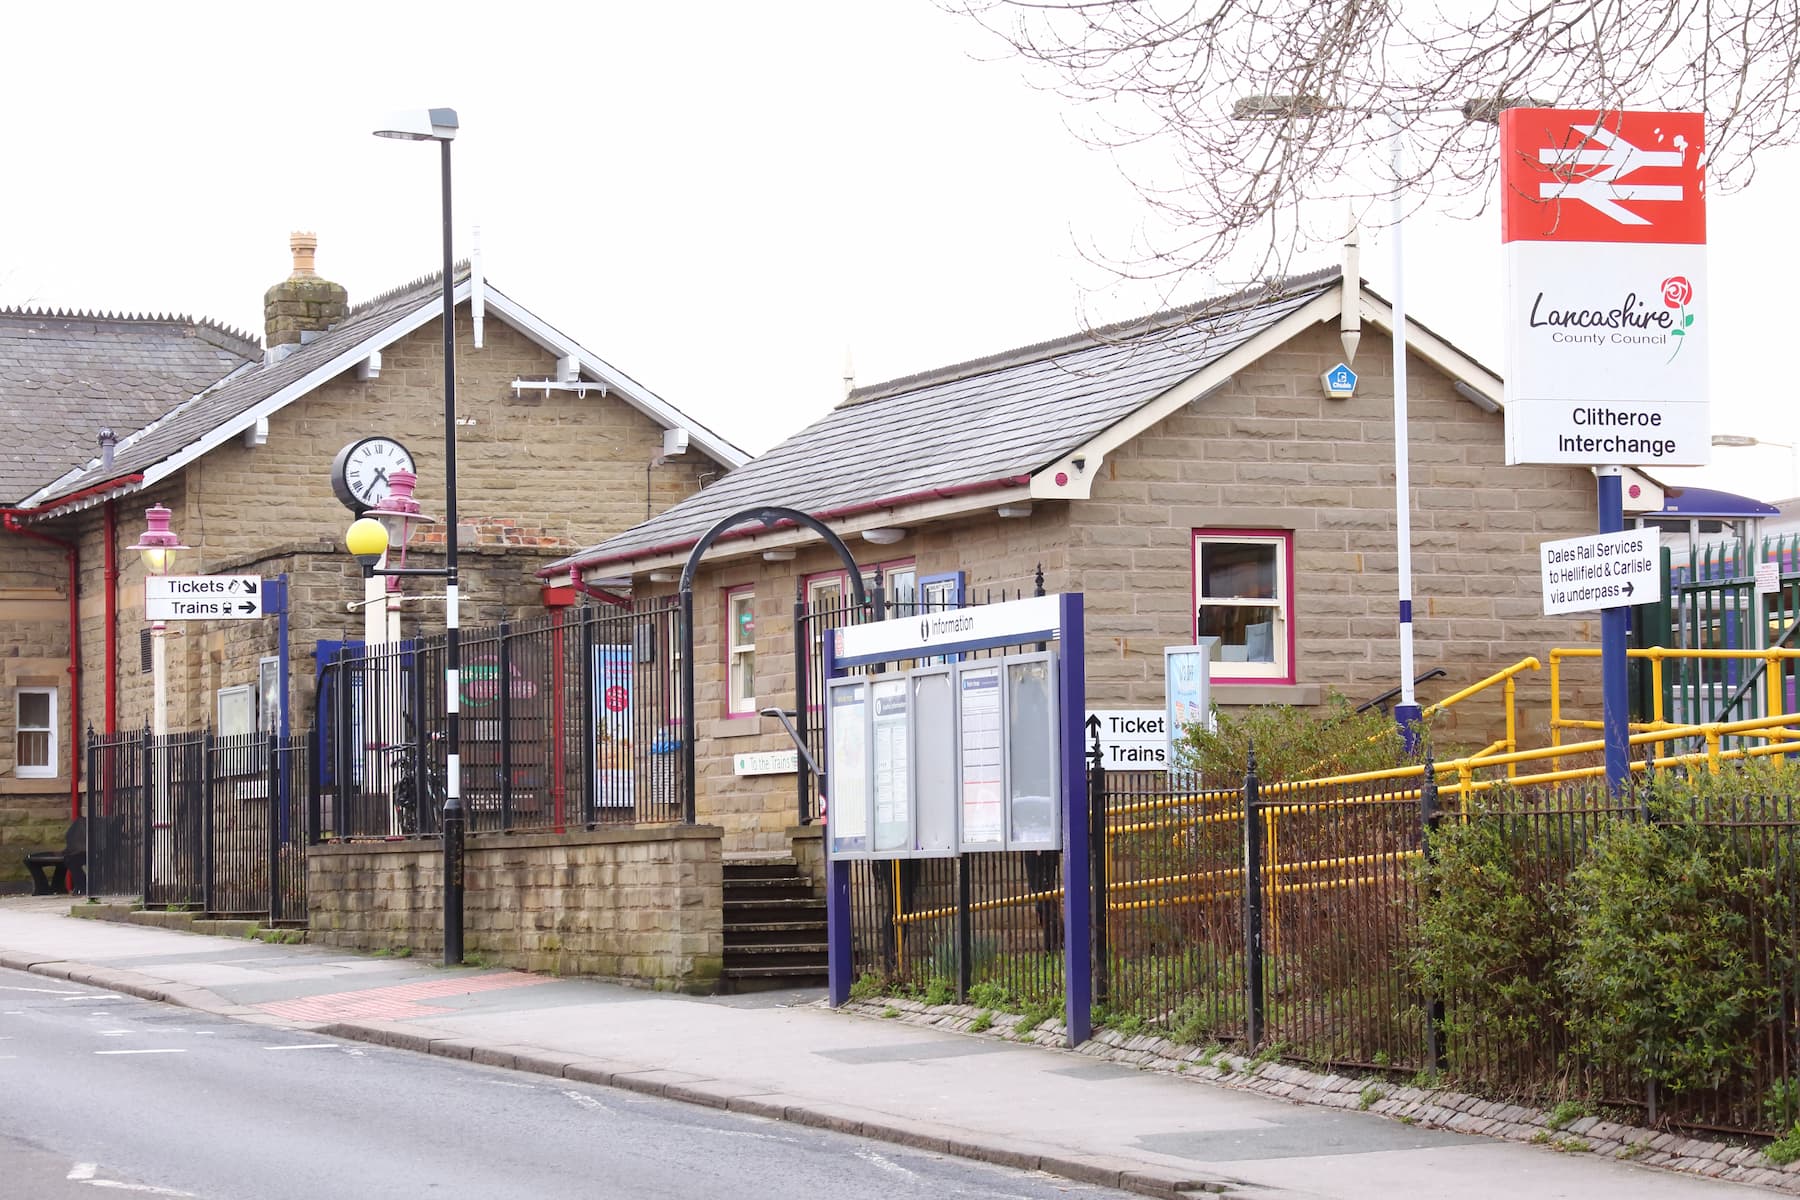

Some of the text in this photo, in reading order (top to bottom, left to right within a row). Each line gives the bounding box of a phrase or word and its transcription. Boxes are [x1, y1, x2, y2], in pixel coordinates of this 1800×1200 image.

[1530, 292, 1673, 329] Lancashire
[1552, 332, 1666, 346] County Council
[1573, 408, 1662, 426] Clitheroe
[1559, 434, 1676, 457] Interchange
[1548, 540, 1643, 564] Dales Rail Services
[1549, 558, 1652, 584] to Hellifield & Carlisle
[168, 580, 224, 593] Tickets
[1551, 584, 1620, 604] via underpass
[171, 601, 218, 614] Trains
[931, 616, 974, 635] Information
[770, 755, 790, 769] Trains
[1109, 745, 1166, 762] Trains
